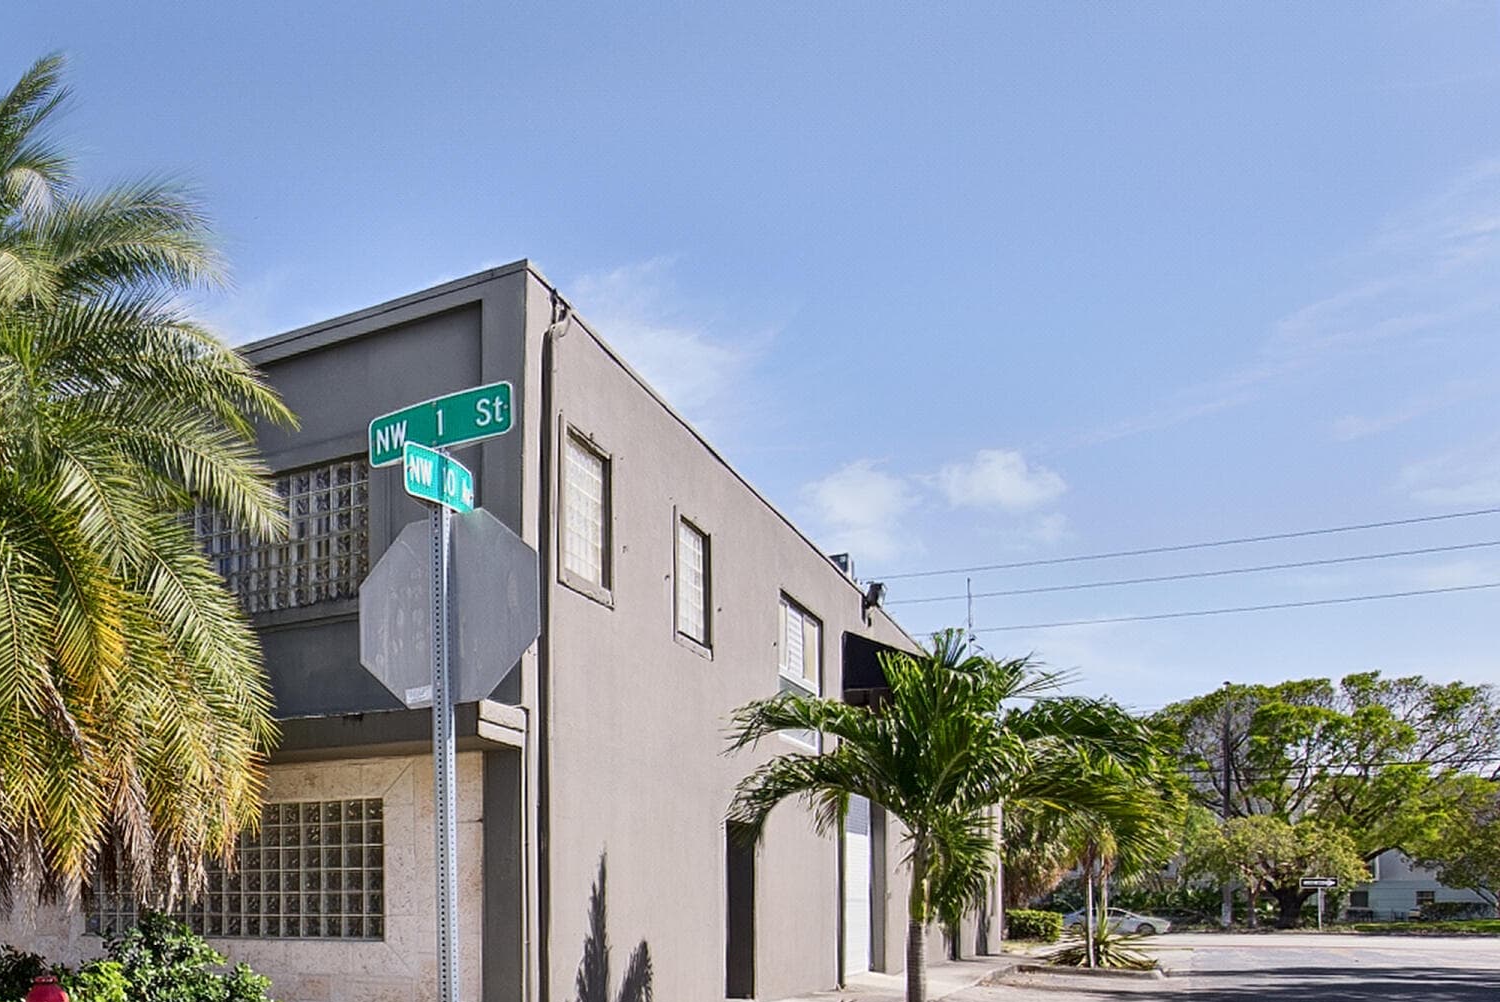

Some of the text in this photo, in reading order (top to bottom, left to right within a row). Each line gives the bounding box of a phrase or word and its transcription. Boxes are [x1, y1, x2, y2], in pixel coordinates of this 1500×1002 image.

[376, 396, 503, 455] NW 1 St
[408, 453, 433, 488] NW
